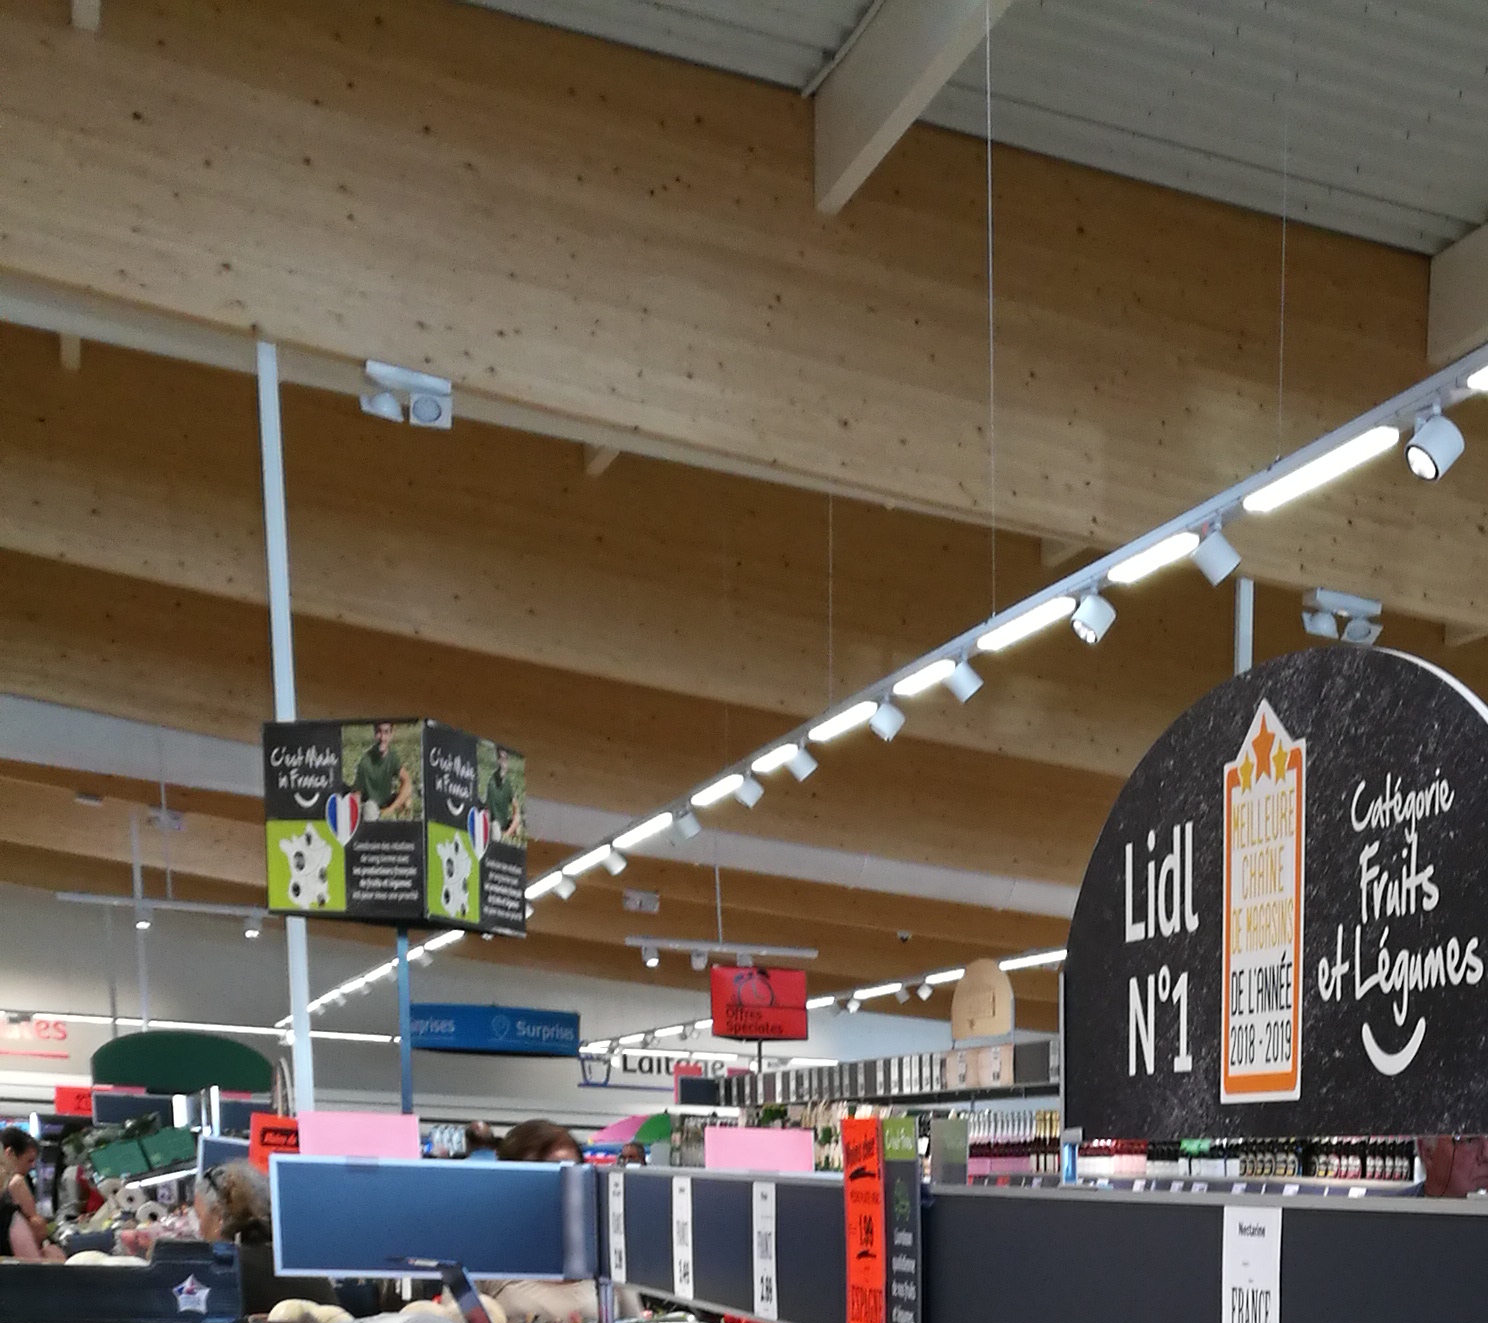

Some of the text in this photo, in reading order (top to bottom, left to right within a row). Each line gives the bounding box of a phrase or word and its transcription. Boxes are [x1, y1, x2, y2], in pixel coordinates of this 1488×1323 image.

[1233, 787, 1295, 849] MEILLEURE
[1351, 768, 1455, 836] Catégorie
[1124, 821, 1200, 943] Lidl
[1242, 845, 1285, 902] CHAÎNE
[1359, 833, 1440, 924] Fruits
[1231, 898, 1294, 955] DE MAGASINS
[1231, 953, 1292, 1016] DE L'ANNÉE
[1318, 925, 1484, 1027] et Légumes
[515, 1021, 575, 1042] Surprises
[725, 1007, 763, 1021] Offres
[725, 1020, 784, 1036] Spéciales
[1229, 1021, 1256, 1066] 2018
[1265, 1018, 1292, 1063] 2019
[1238, 1221, 1266, 1238] Nectarine
